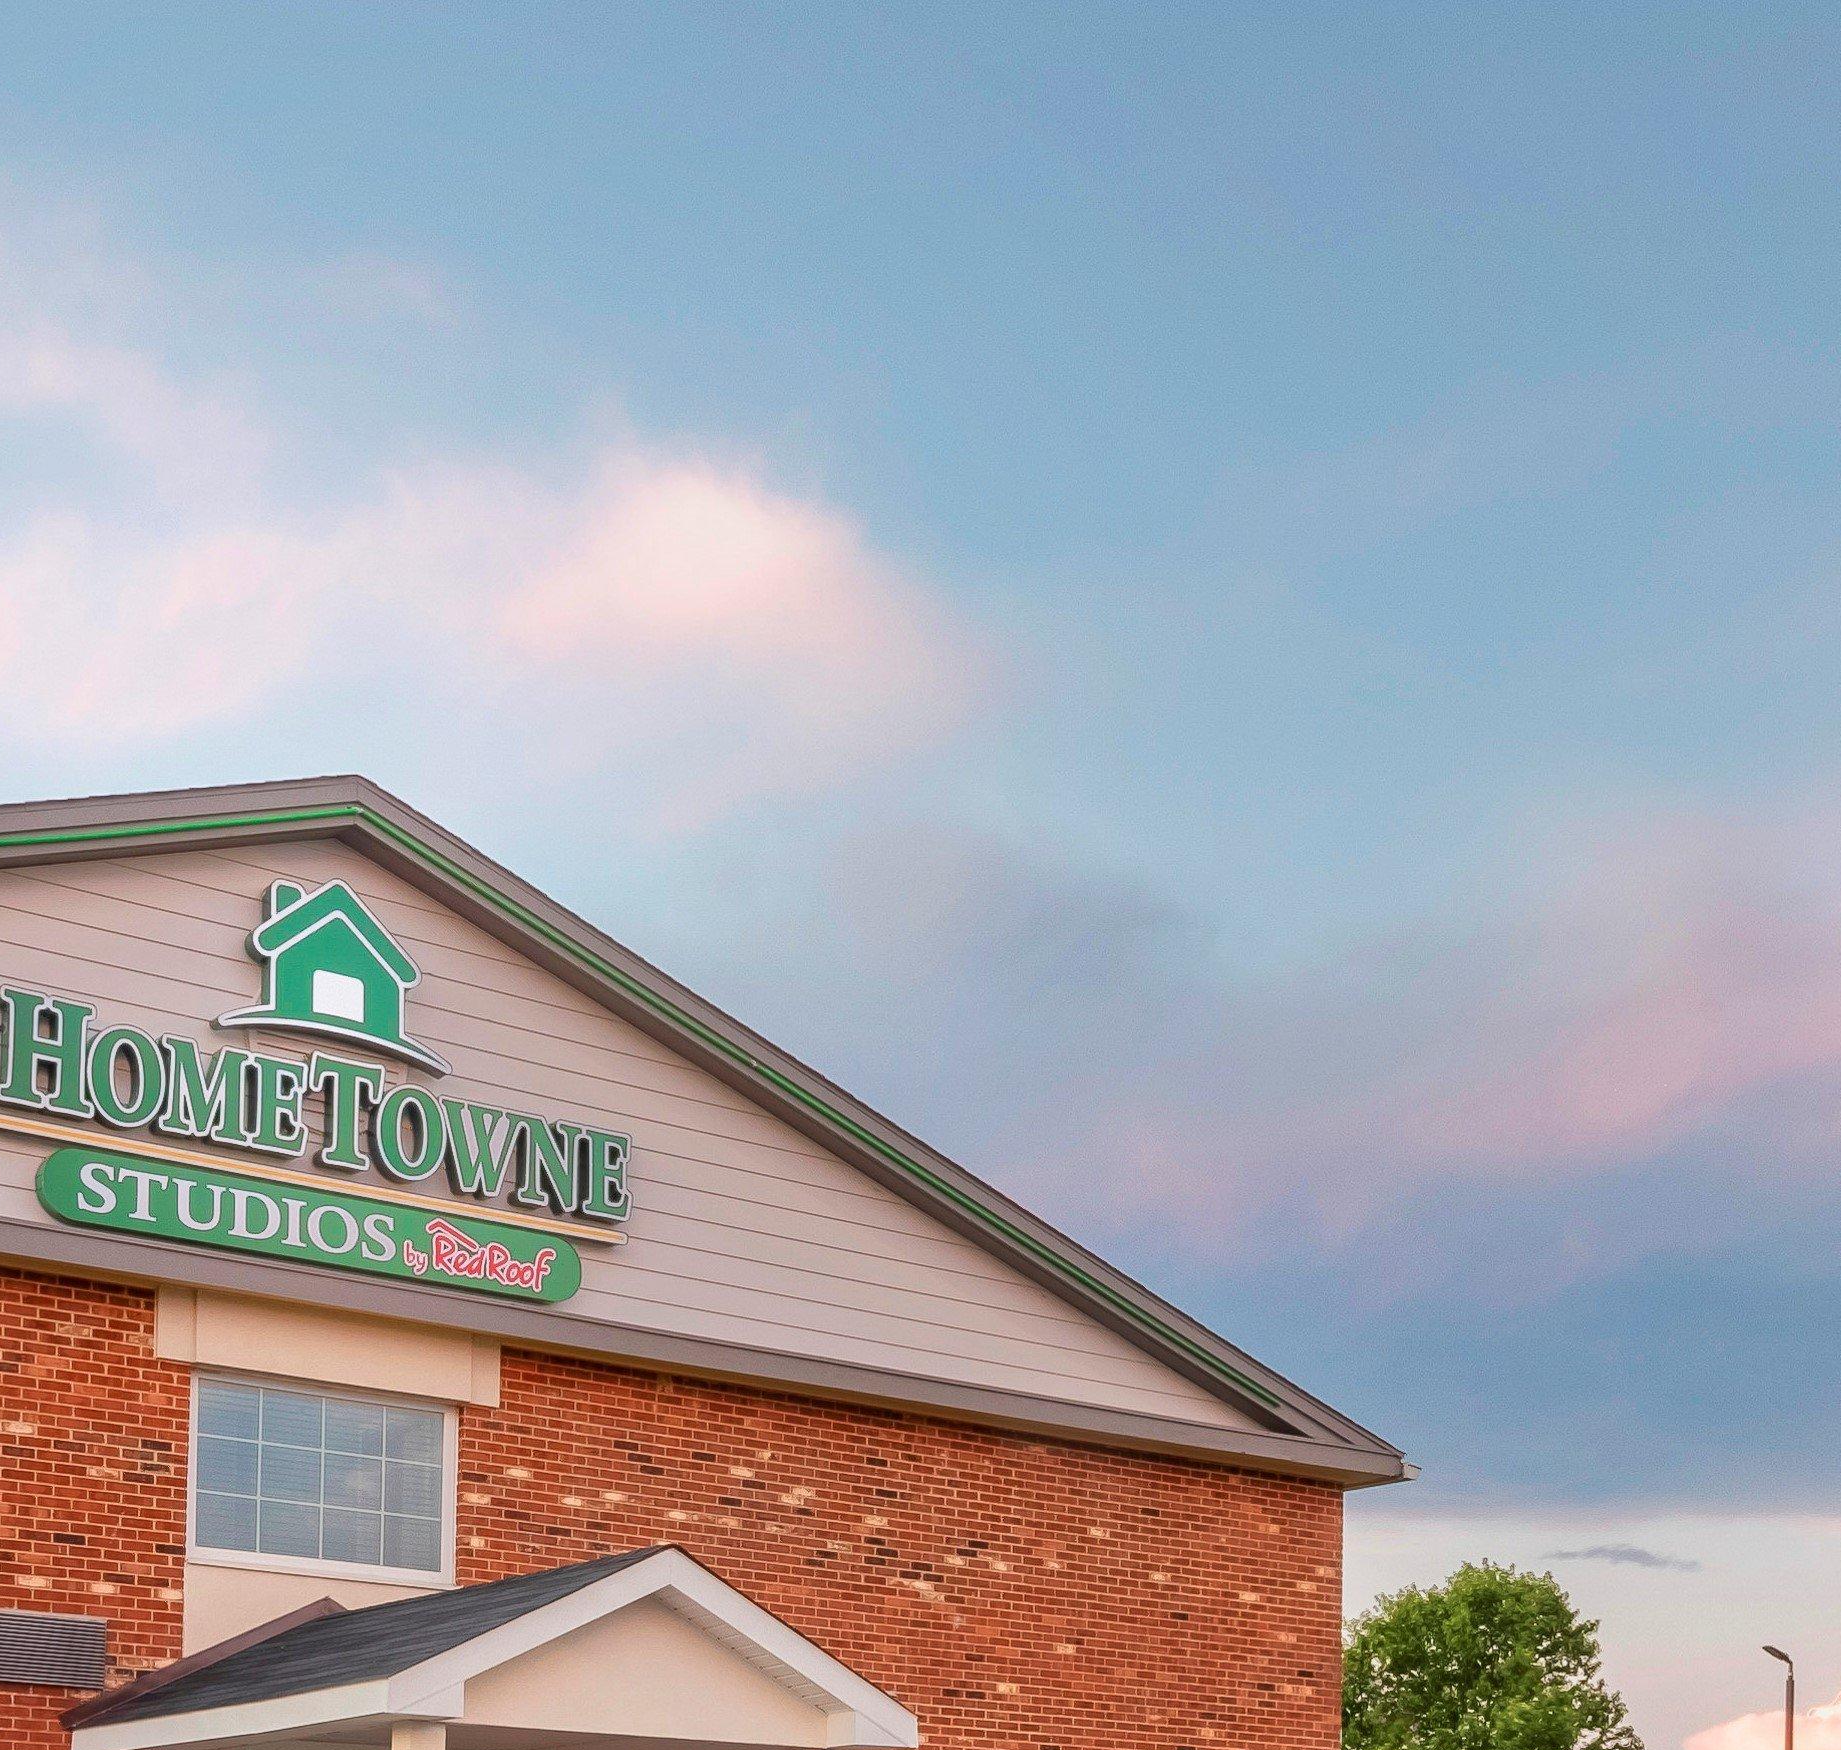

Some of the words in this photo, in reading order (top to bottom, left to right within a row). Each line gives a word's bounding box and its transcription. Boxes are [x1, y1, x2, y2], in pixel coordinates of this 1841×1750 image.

[77, 1162, 397, 1262] STUDIOS
[404, 1240, 428, 1275] by
[432, 1232, 487, 1278] Red
[487, 1242, 556, 1293] Roof
